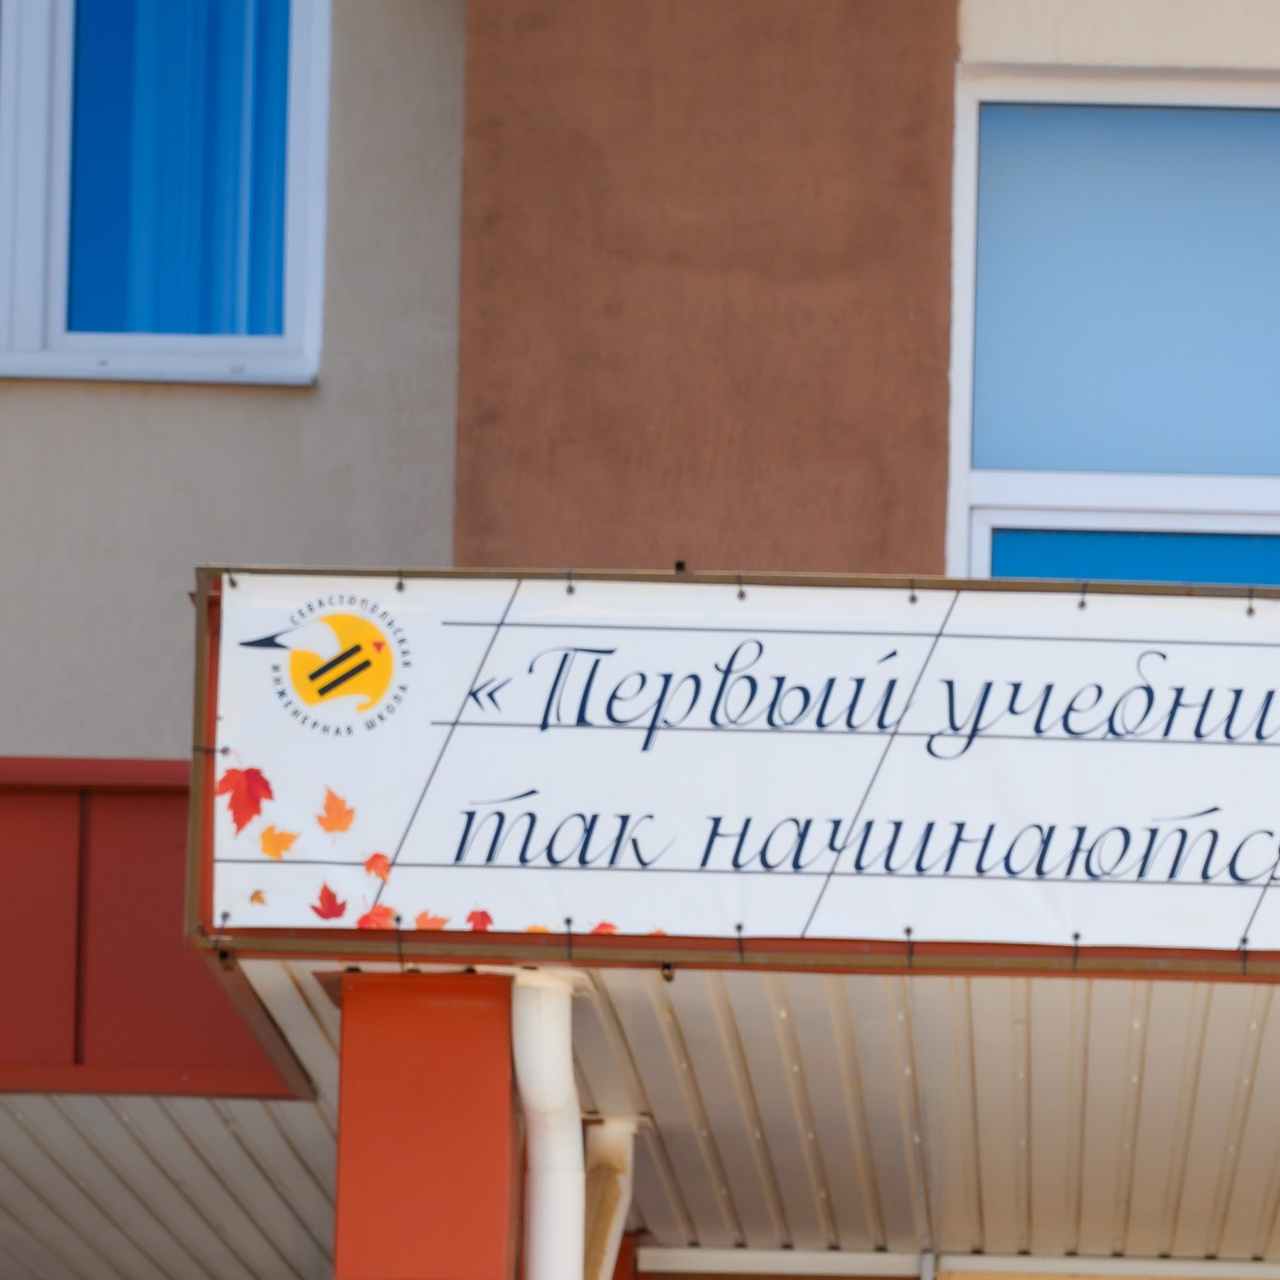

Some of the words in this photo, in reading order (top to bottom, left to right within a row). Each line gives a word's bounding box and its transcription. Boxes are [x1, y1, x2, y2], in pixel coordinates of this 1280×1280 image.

[364, 684, 407, 730] ШКОЛА
[468, 639, 910, 752] «Первый
[453, 789, 680, 868] так
